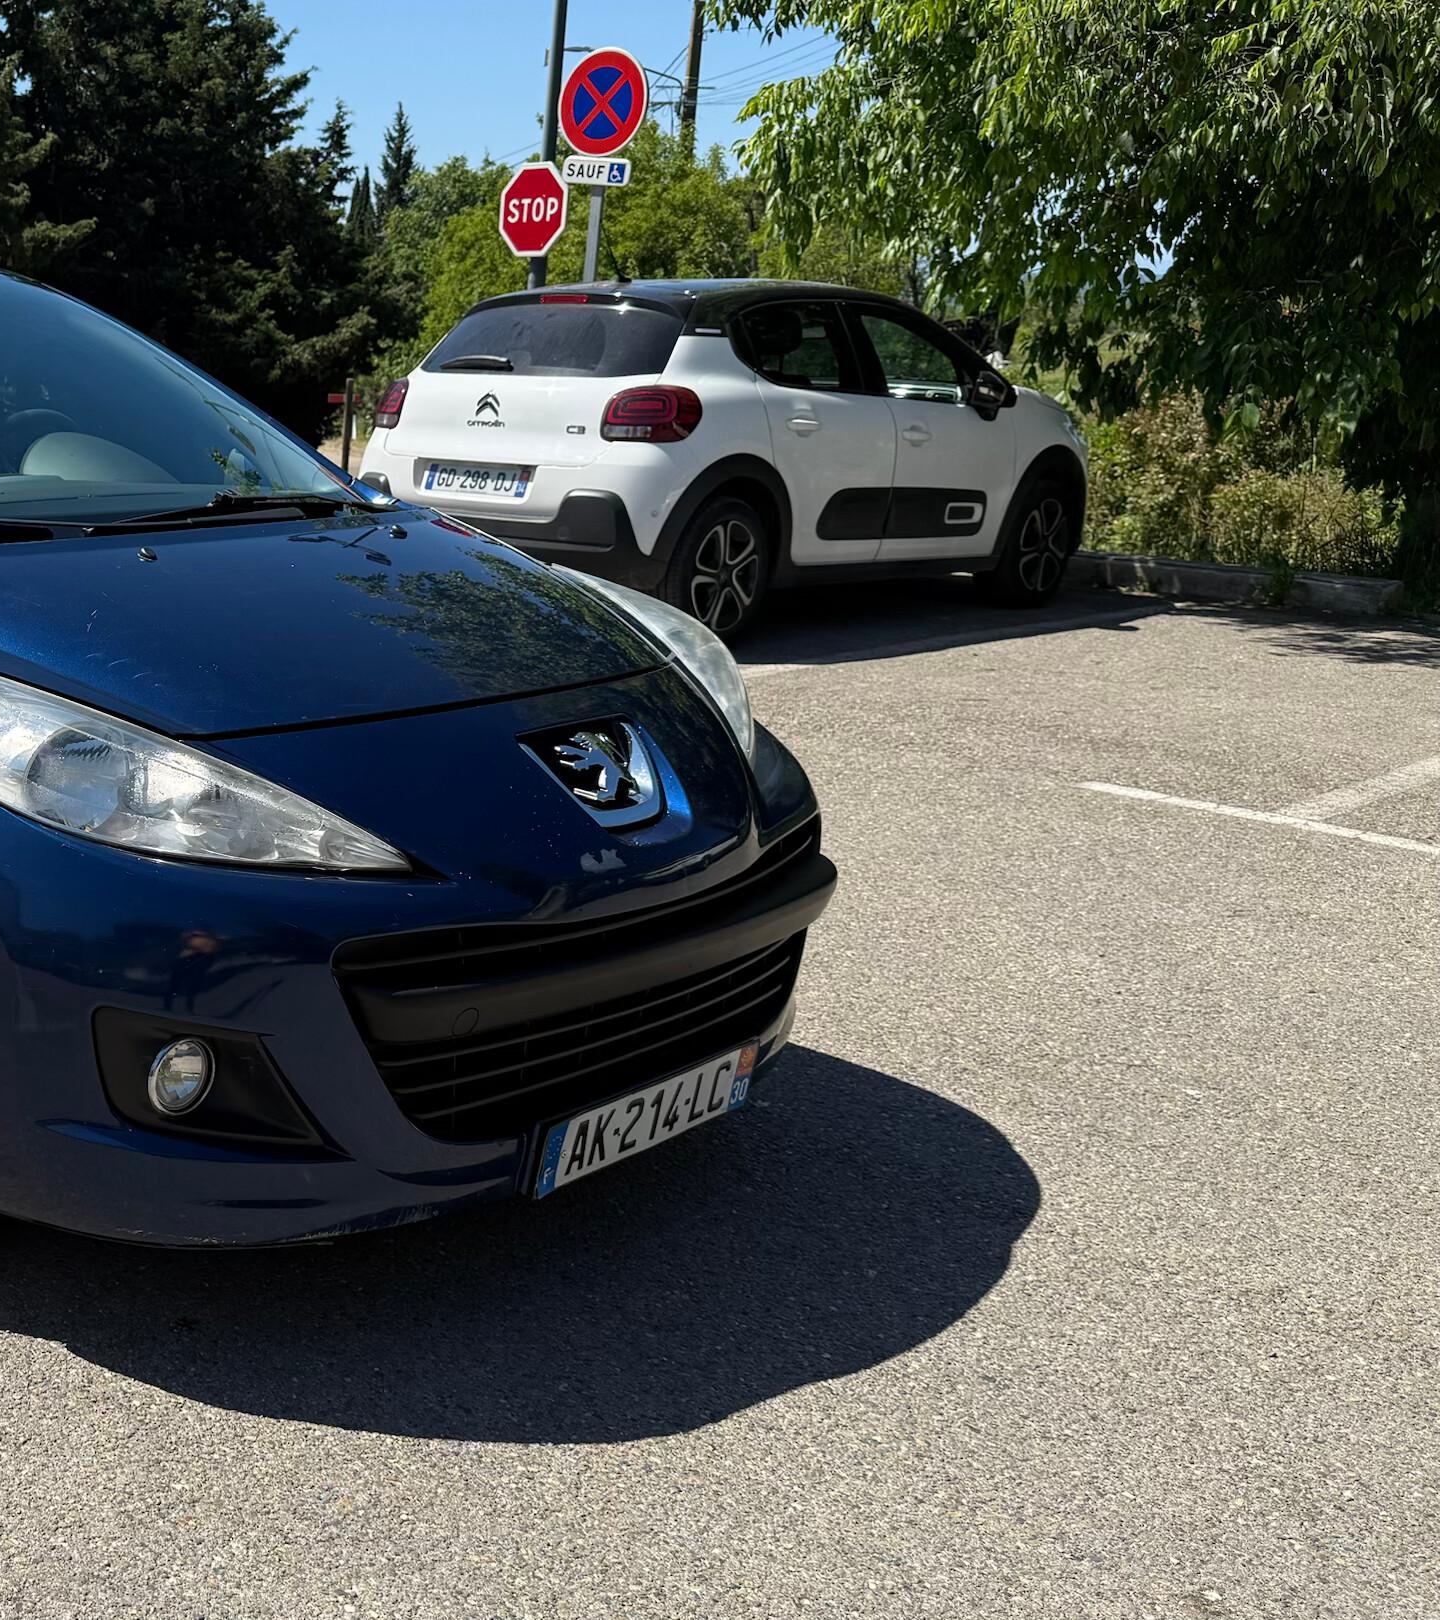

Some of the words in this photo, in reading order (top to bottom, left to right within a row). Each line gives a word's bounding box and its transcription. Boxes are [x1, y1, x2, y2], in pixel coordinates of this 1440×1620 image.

[567, 163, 606, 179] SAUF
[507, 197, 559, 223] STOP
[543, 1167, 555, 1184] F
[730, 1078, 749, 1104] 30
